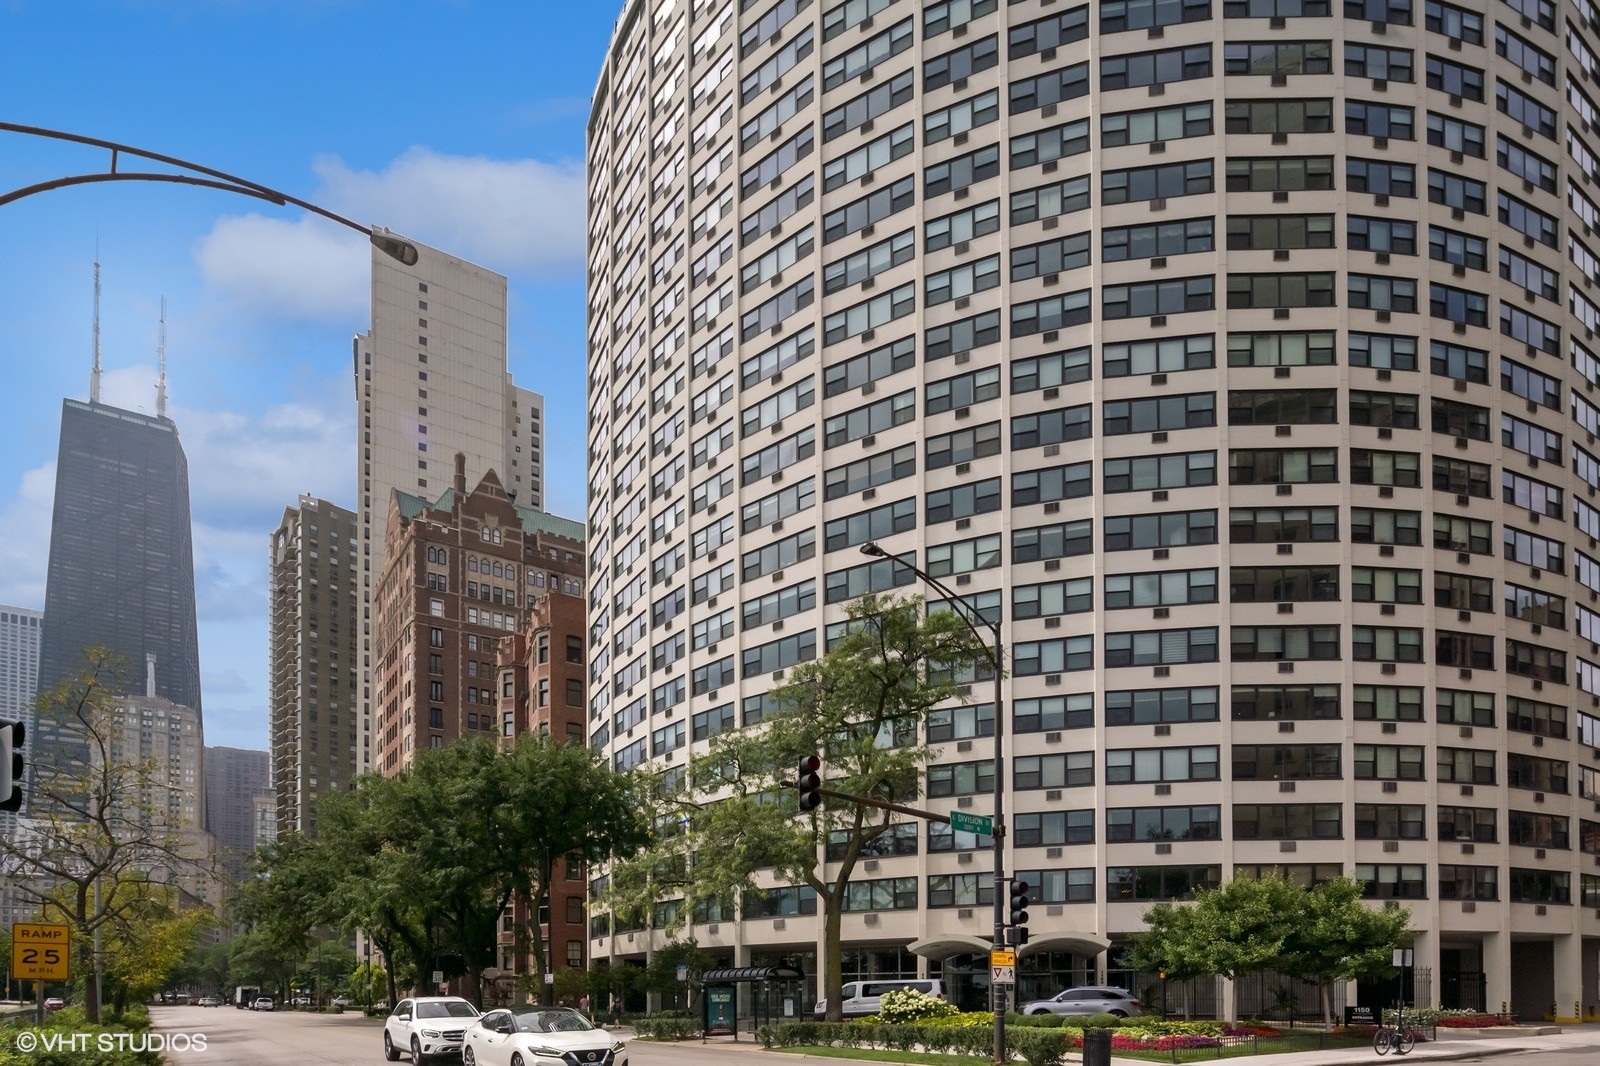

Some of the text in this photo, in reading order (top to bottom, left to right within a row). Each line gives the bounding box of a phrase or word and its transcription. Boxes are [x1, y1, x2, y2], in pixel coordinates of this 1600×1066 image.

[957, 814, 983, 826] DIVISION
[21, 929, 62, 939] RAMP
[22, 948, 60, 965] 25
